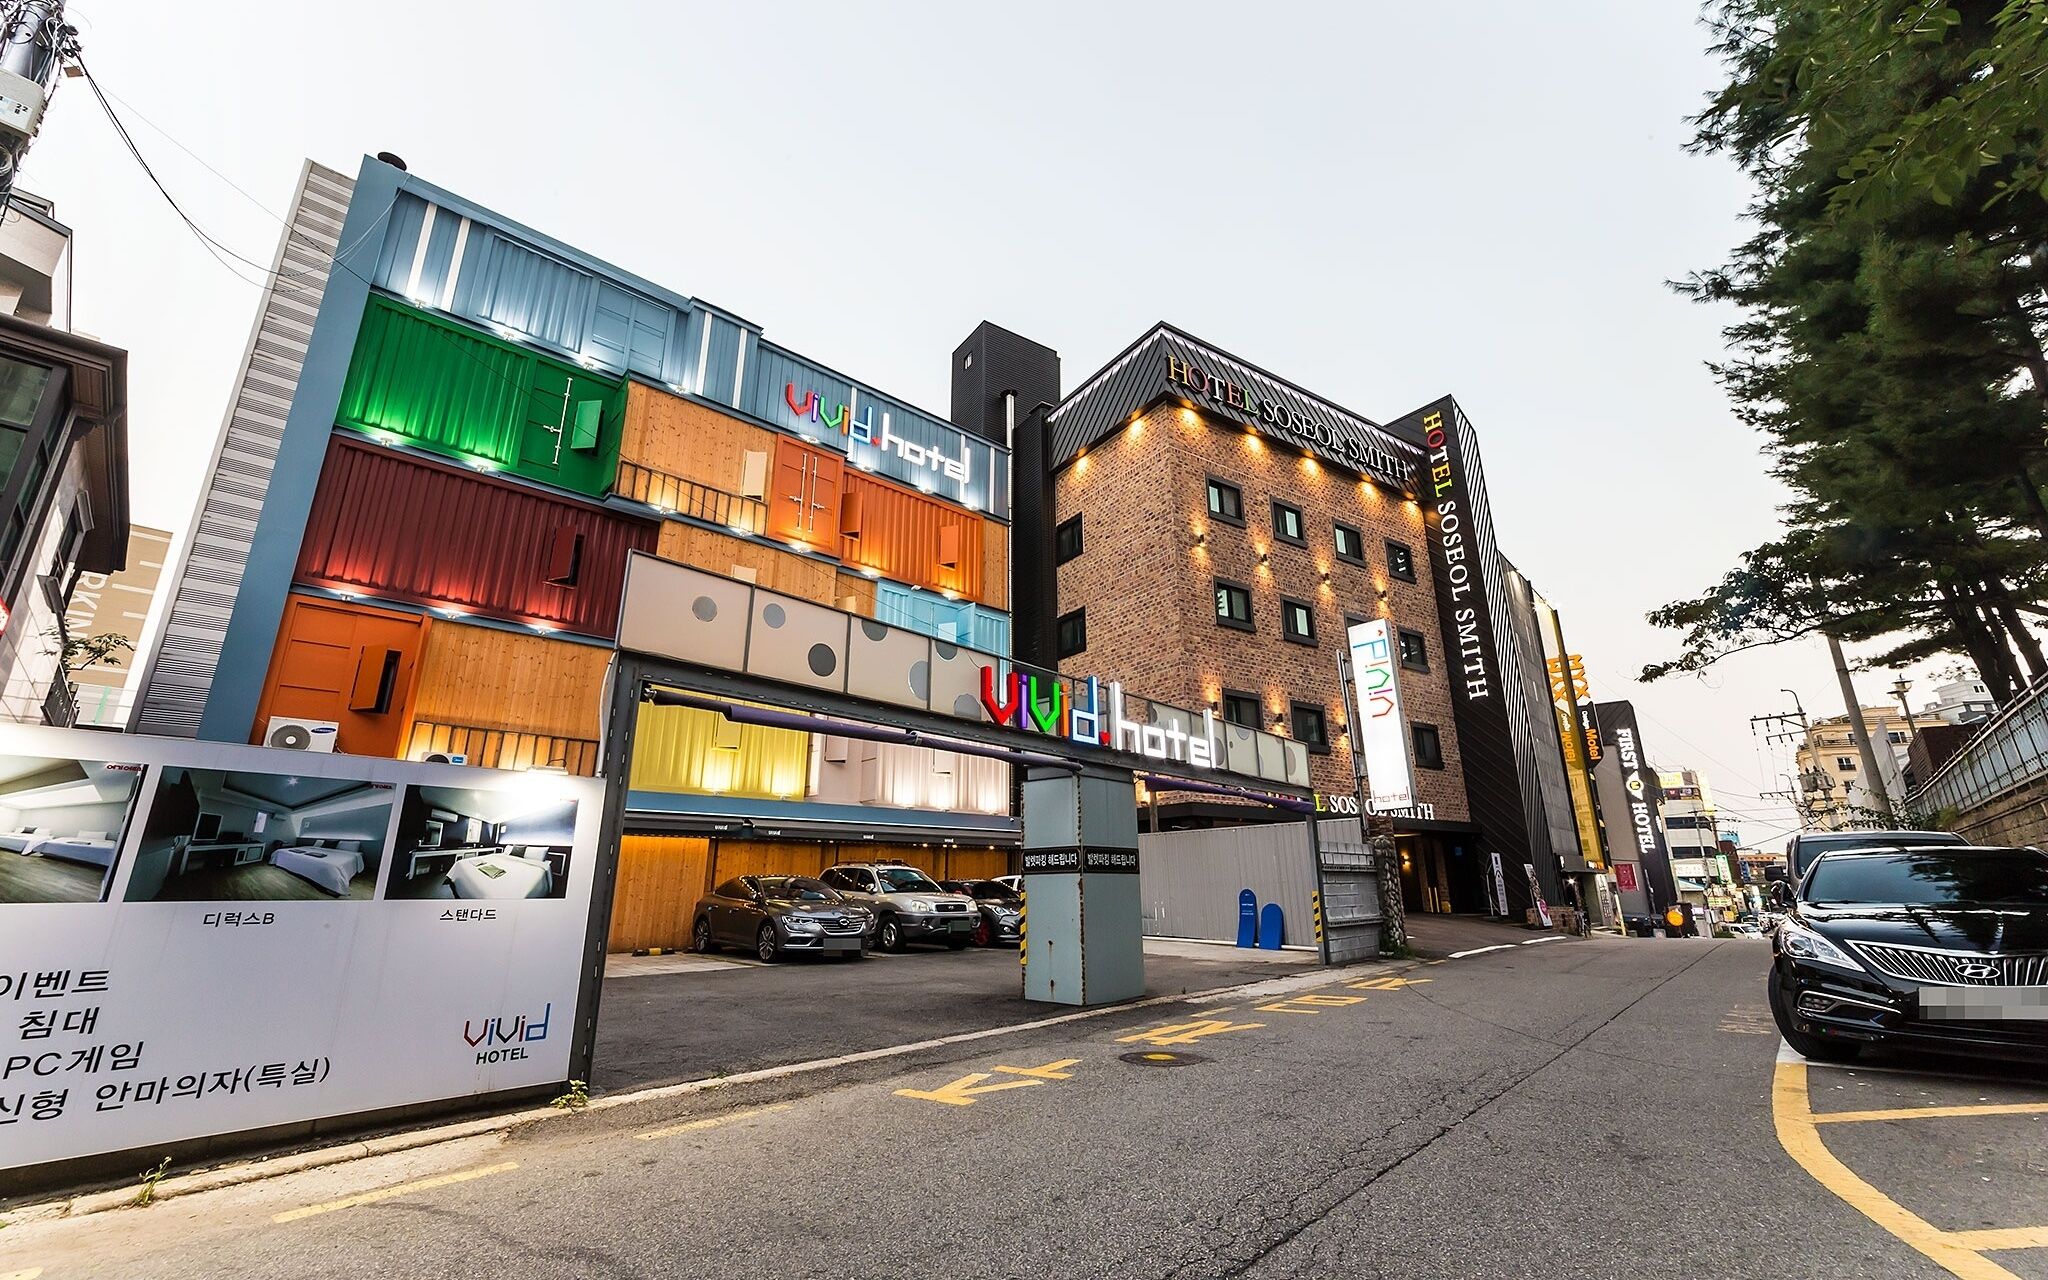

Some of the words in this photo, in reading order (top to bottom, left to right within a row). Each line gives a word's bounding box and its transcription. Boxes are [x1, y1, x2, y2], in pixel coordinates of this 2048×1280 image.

[1168, 355, 1260, 416] HOTEL
[1262, 399, 1345, 453] SOSEOL
[1348, 437, 1410, 481] SMITH
[881, 412, 971, 484] hotel
[1423, 411, 1453, 498] HOTEL
[1437, 500, 1472, 602] SOSEOL
[1455, 608, 1489, 700] SMITH
[1109, 681, 1217, 769] hotel
[1585, 728, 1601, 760] Motel
[1616, 728, 1638, 769] FIRST
[1632, 802, 1656, 854] HOTEL
[1048, 852, 1078, 866] 해드립니다
[1111, 854, 1136, 866] 해드립니다
[202, 911, 275, 927] 디럭스B
[439, 908, 497, 922] 스탠다드
[0, 970, 110, 1000] 이벤트
[19, 1006, 100, 1040] 침대
[3, 1041, 144, 1080] PC게임
[475, 1047, 529, 1065] HOTEL
[0, 1088, 69, 1125] 신형
[95, 1056, 330, 1112] 안마의자(특실)
